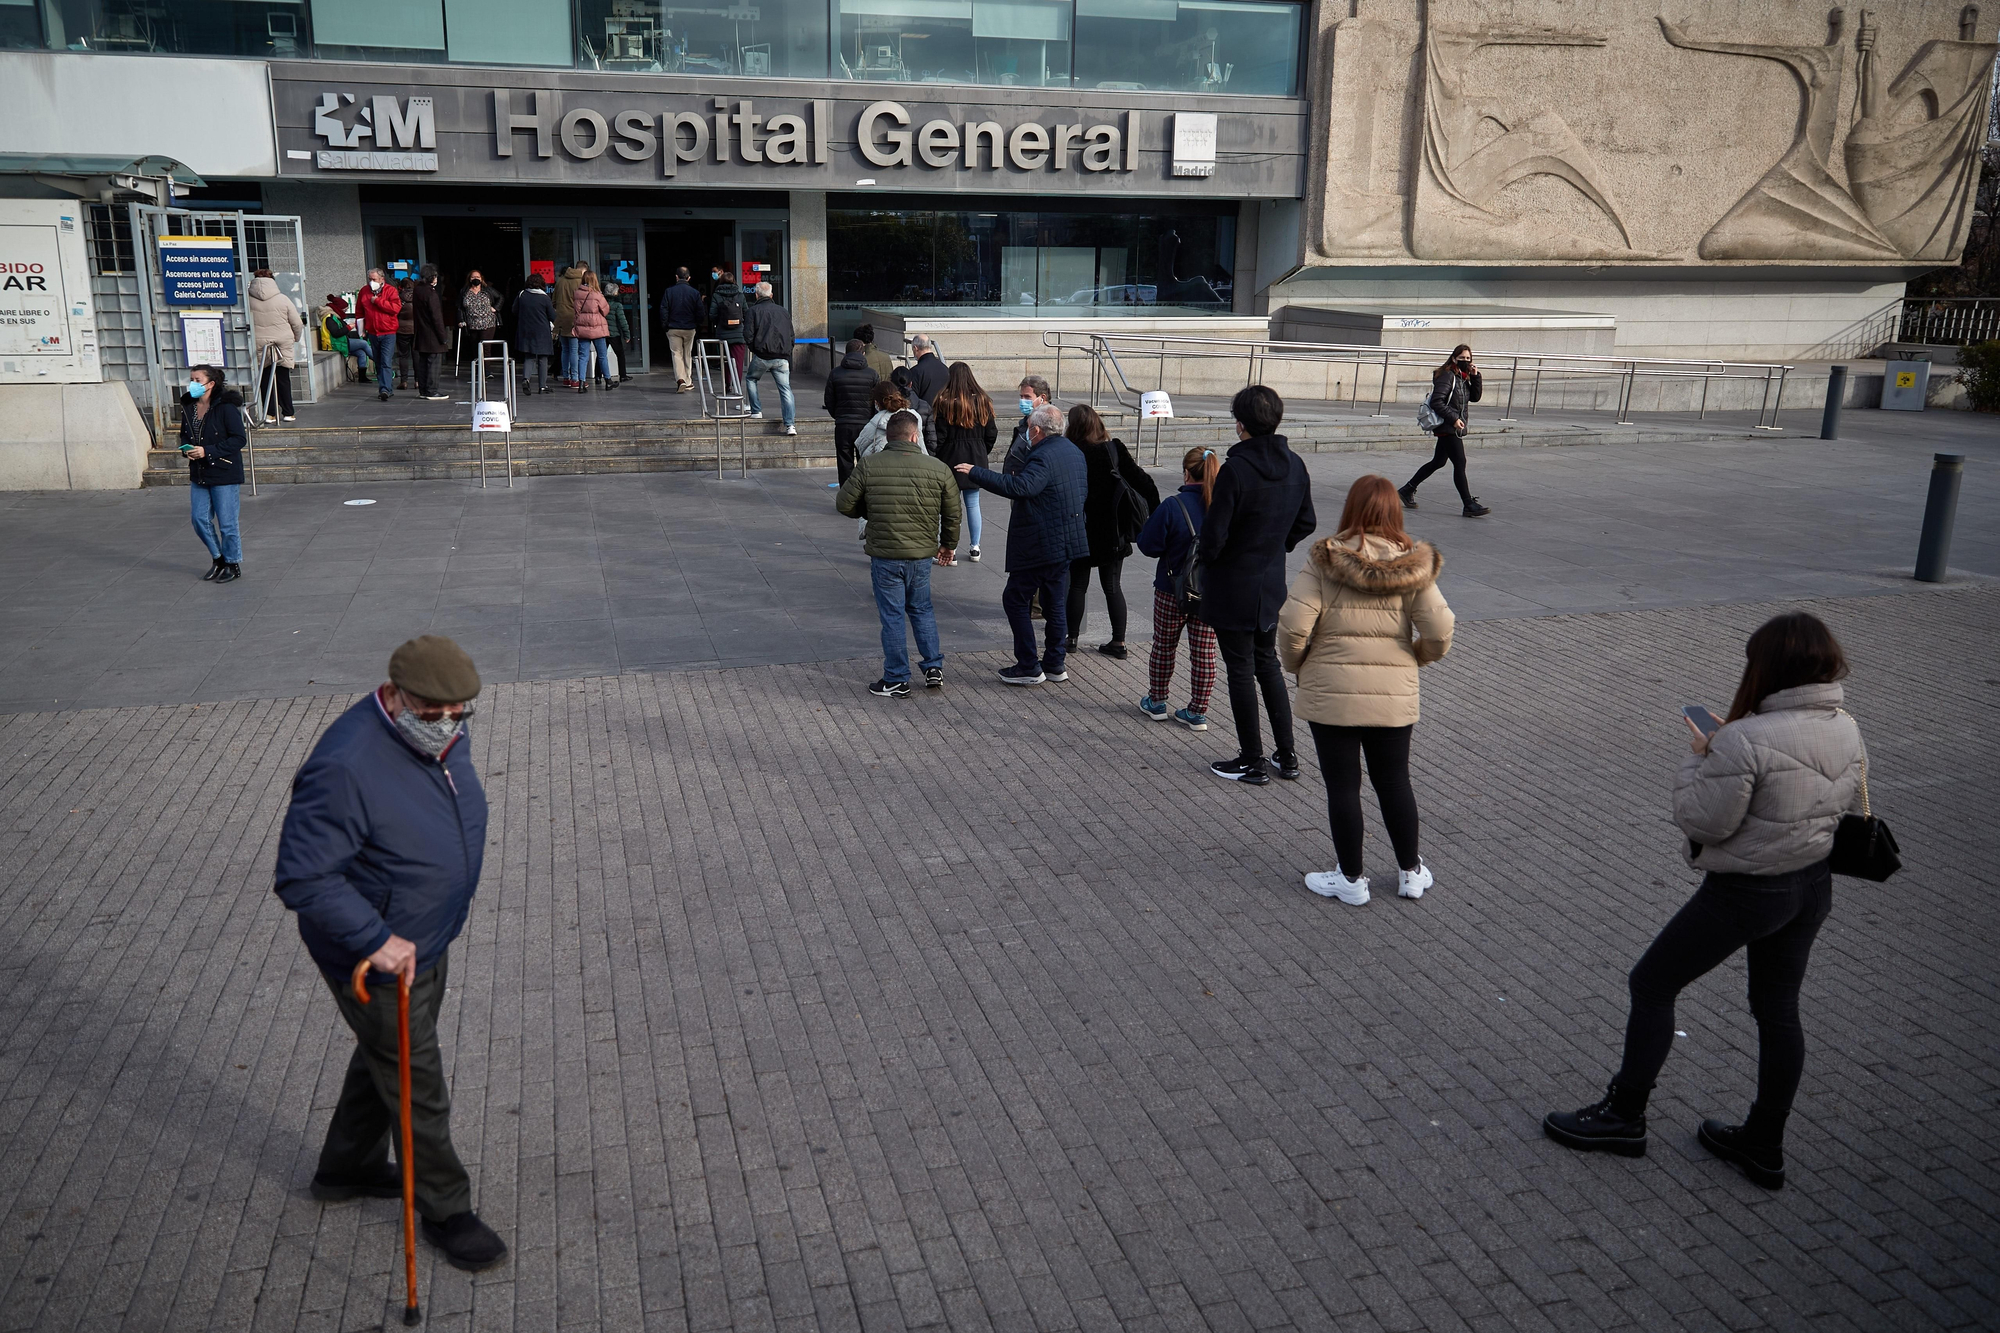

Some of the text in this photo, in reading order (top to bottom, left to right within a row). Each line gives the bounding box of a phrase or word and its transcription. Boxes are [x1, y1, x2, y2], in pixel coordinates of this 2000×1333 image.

[494, 88, 1141, 176] Hospital General
[1173, 165, 1215, 176] Madrid
[165, 254, 189, 263] Acceso
[189, 254, 200, 263] sin
[165, 270, 201, 278] Ascensores
[210, 270, 220, 278] los
[220, 270, 233, 278] dos
[177, 281, 202, 289] accesos
[202, 280, 219, 290] junto
